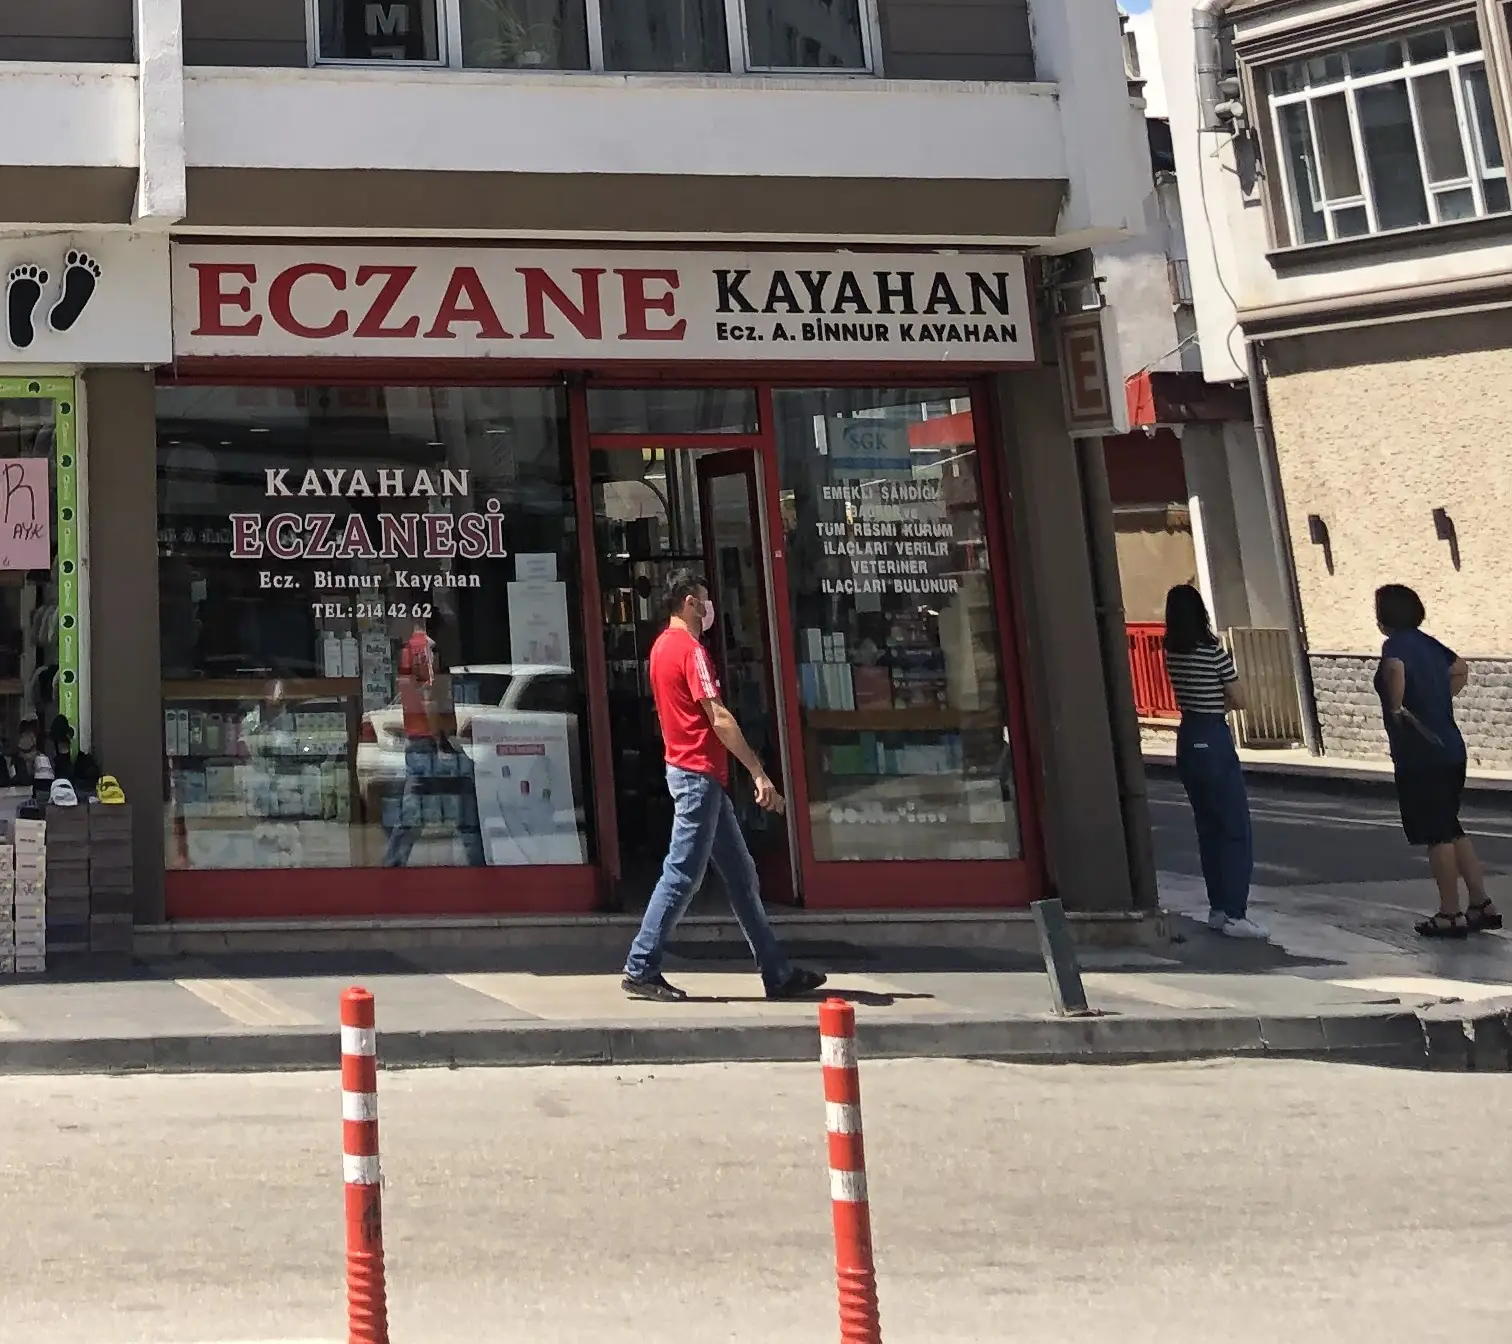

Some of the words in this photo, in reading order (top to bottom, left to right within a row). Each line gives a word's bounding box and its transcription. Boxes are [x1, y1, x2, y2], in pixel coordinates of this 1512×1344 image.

[712, 269, 1010, 315] KAYAHAN
[188, 262, 687, 343] ECZANE
[716, 321, 764, 342] Ecz.
[772, 322, 796, 342] A.
[802, 317, 889, 342] BİNNUR
[900, 323, 1018, 343] KAYAHAN
[849, 432, 888, 450] SGK
[264, 468, 470, 497] KAYAHAN
[12, 522, 44, 540] AYK
[229, 498, 507, 559] ECZANESİ
[816, 522, 846, 537] TÜM
[902, 523, 954, 537] KURUM
[824, 541, 888, 556] İLAÇLARI
[851, 561, 928, 575] VETERİNER
[259, 571, 300, 589] Ecz.
[313, 570, 382, 589] Binnur
[394, 570, 481, 593] Kayahan
[822, 579, 886, 594] İLAÇLARI
[894, 579, 959, 594] BULUNUR
[387, 602, 407, 619] 42
[411, 602, 433, 619] 62
